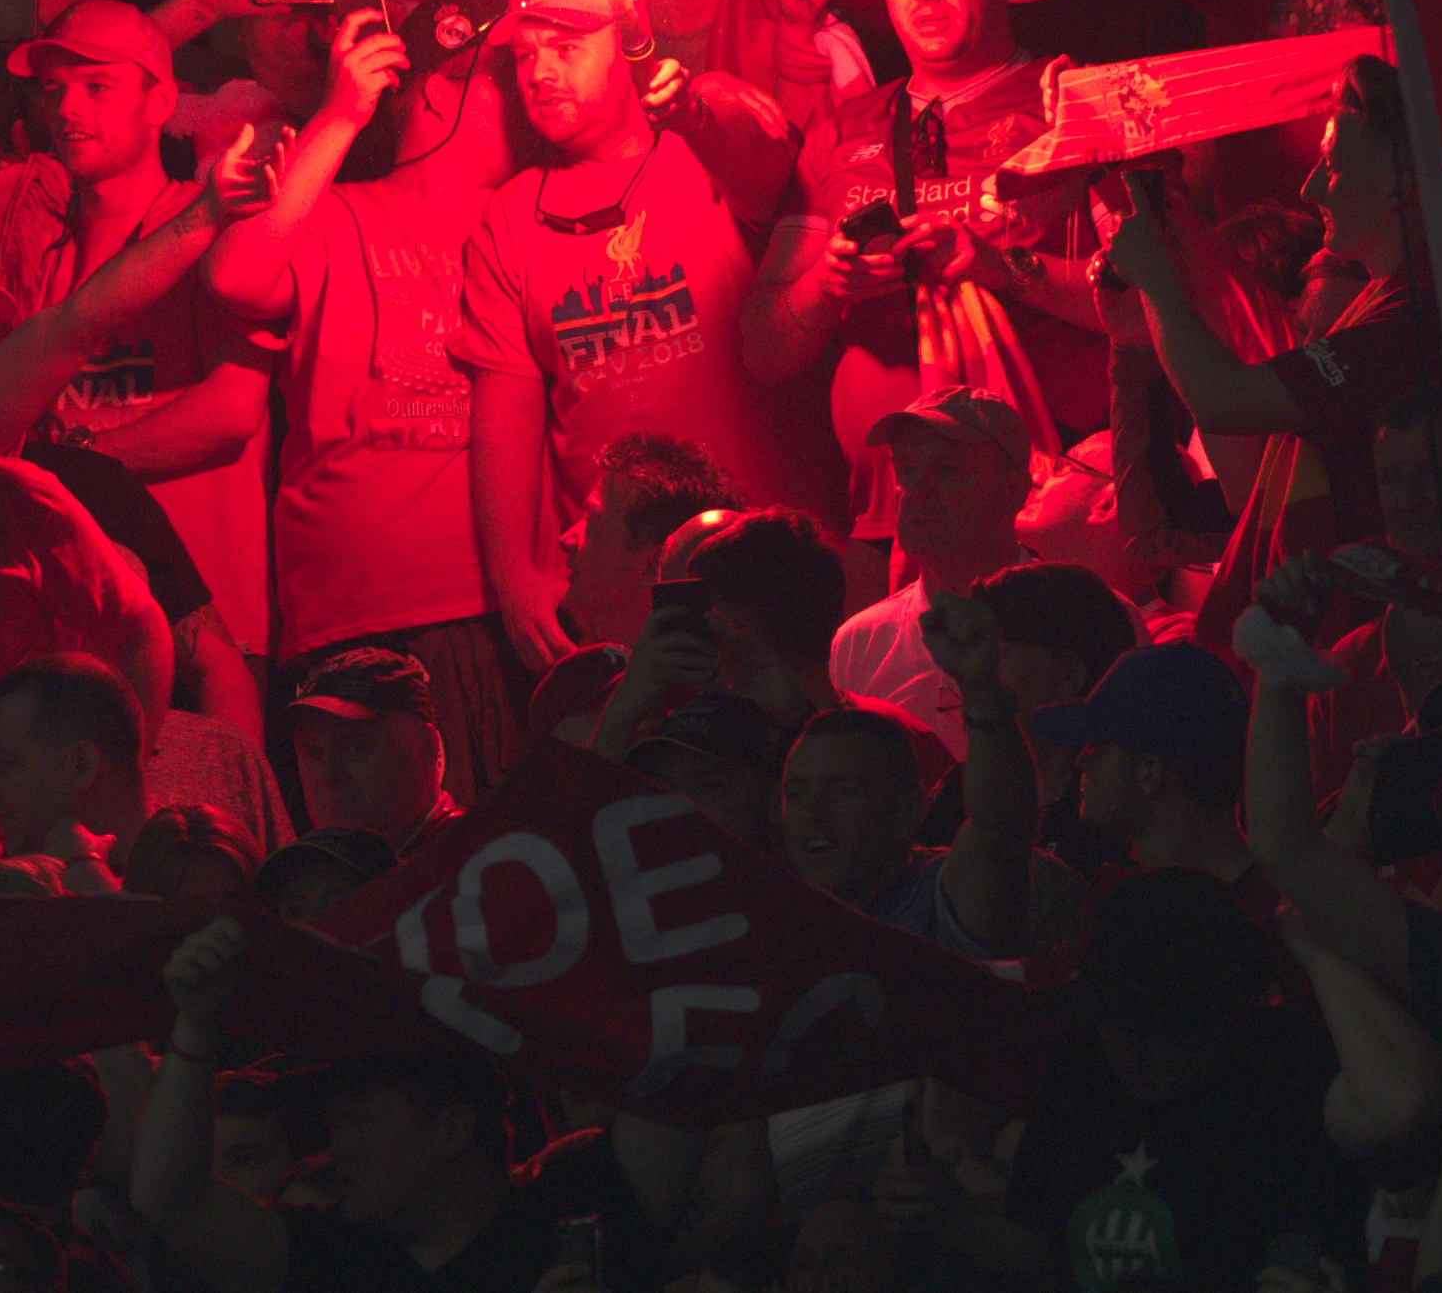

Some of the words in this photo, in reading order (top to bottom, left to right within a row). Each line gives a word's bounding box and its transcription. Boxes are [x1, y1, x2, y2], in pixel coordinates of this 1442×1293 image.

[559, 304, 700, 372] FINAL
[637, 332, 705, 370] 2018
[56, 373, 153, 411] NAL
